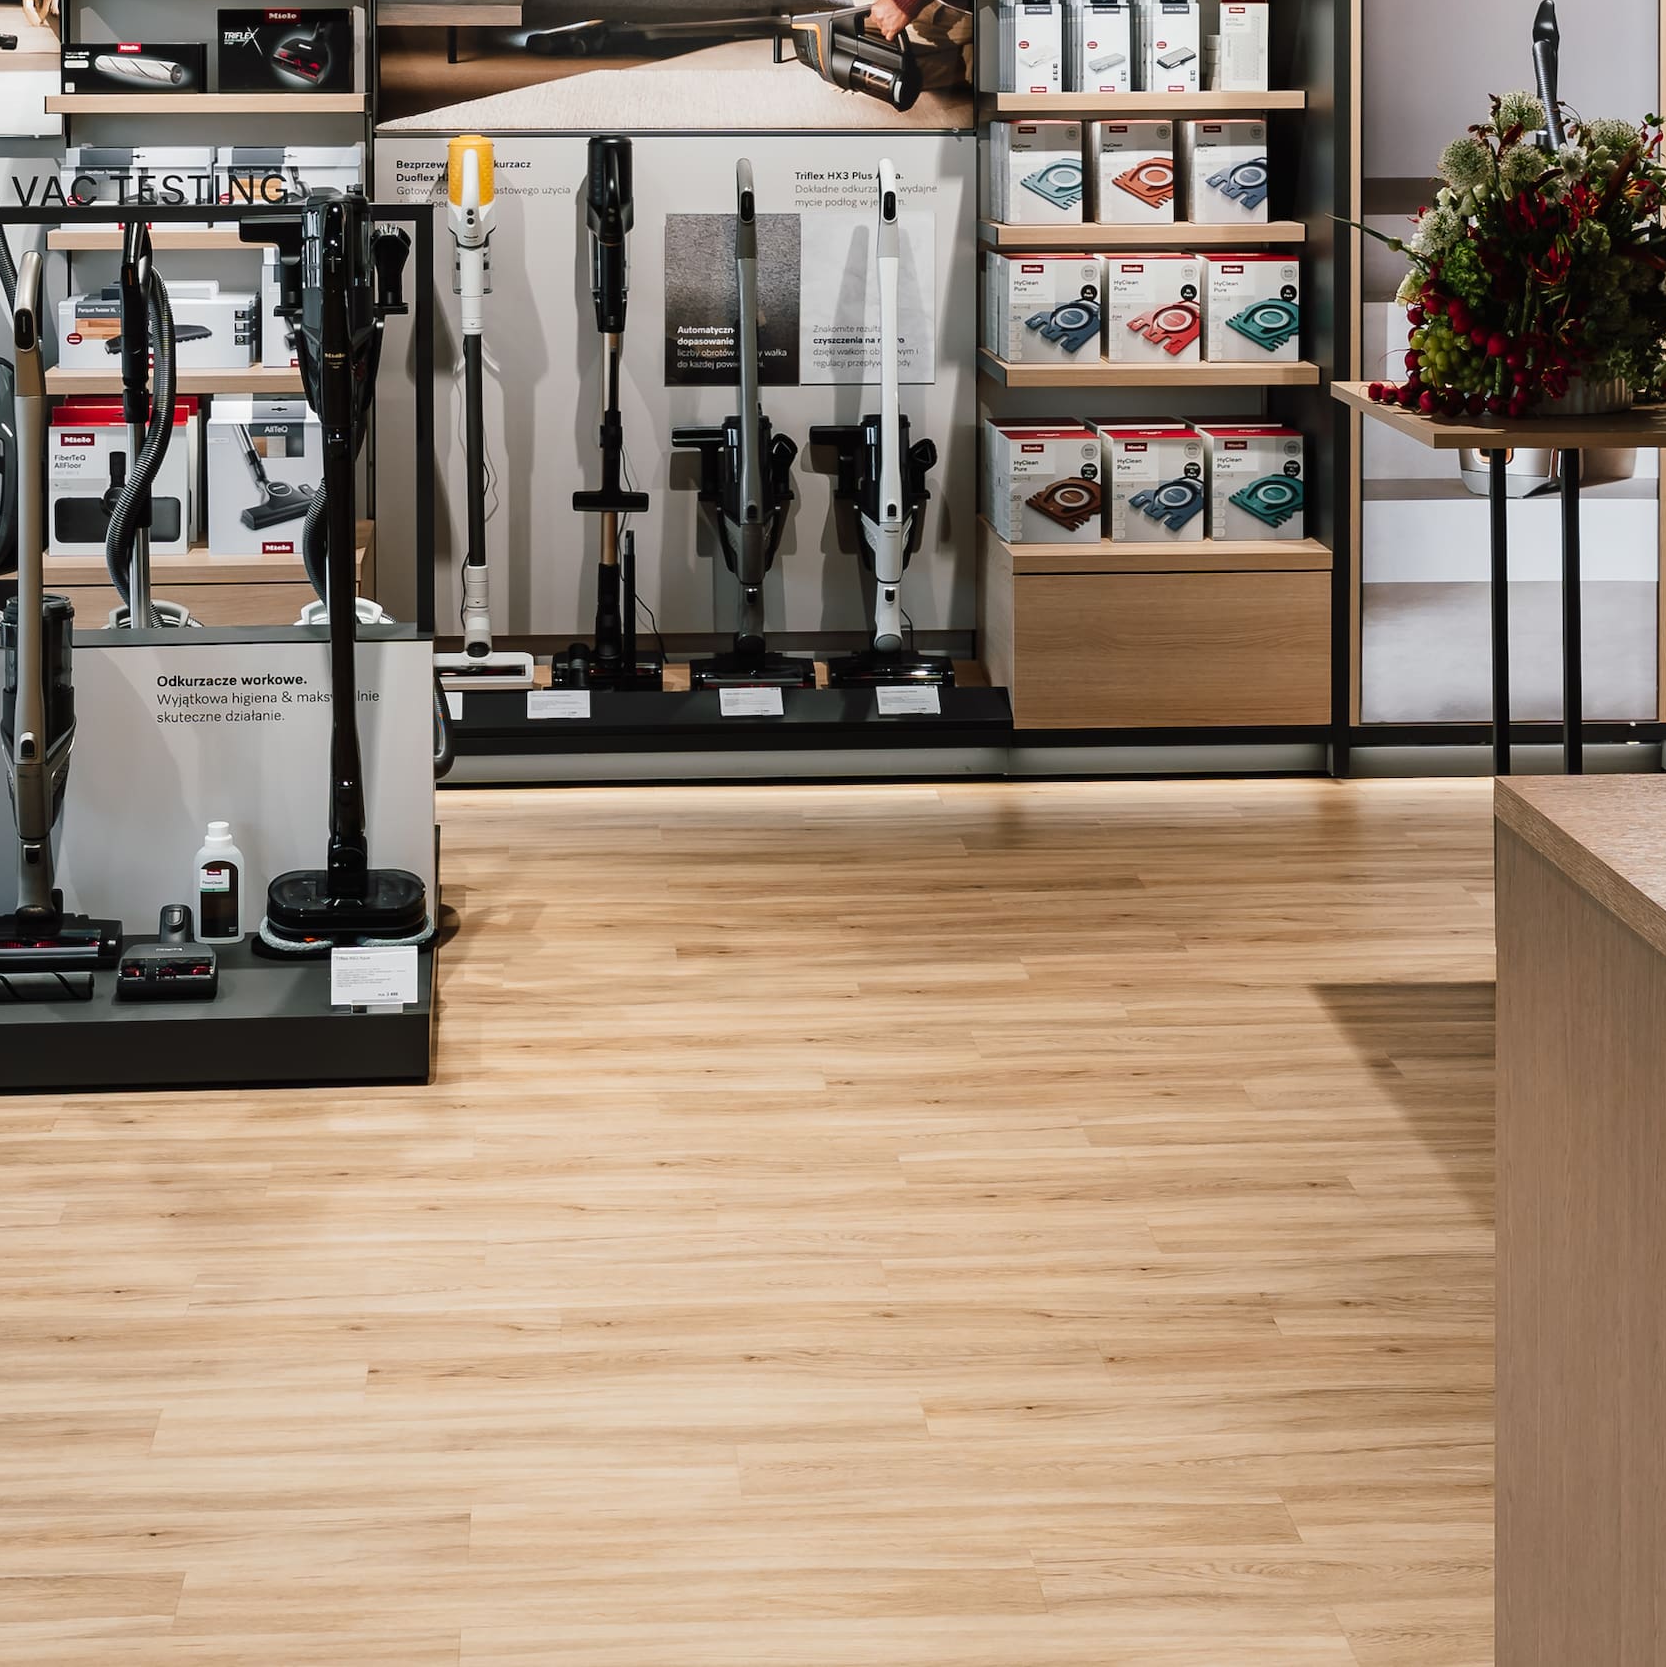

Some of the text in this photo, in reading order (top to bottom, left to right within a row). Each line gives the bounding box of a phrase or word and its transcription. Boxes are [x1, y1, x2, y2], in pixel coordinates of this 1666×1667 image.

[397, 174, 435, 182] Duoflex
[795, 172, 873, 180] Triflex HX3 Plus
[12, 176, 97, 207] VAC
[109, 173, 289, 205] TESTING
[397, 187, 433, 197] Gotowy
[437, 187, 449, 195] do
[796, 185, 937, 195] Dokładne wydajne
[796, 199, 822, 207] mycie
[825, 198, 857, 208] podłóg
[1114, 279, 1139, 287] HyClean
[814, 325, 854, 333] Znakomite
[677, 337, 734, 348] dopasowanie
[814, 336, 863, 345] czyszczenia
[677, 349, 700, 358] liczby
[702, 349, 735, 357] obrotów
[837, 348, 868, 356] wałkom
[677, 360, 688, 369] do
[814, 359, 846, 369] regulacji
[265, 425, 288, 433] AllTeQ
[54, 454, 86, 462] FiberTeQ
[265, 544, 290, 552] Miele
[157, 674, 307, 687] Odkurzacze workowe.
[157, 693, 228, 708] Wyjątkowa
[233, 692, 277, 707] higiena
[282, 691, 293, 703] &
[157, 711, 284, 724] skuteczne działanie.
